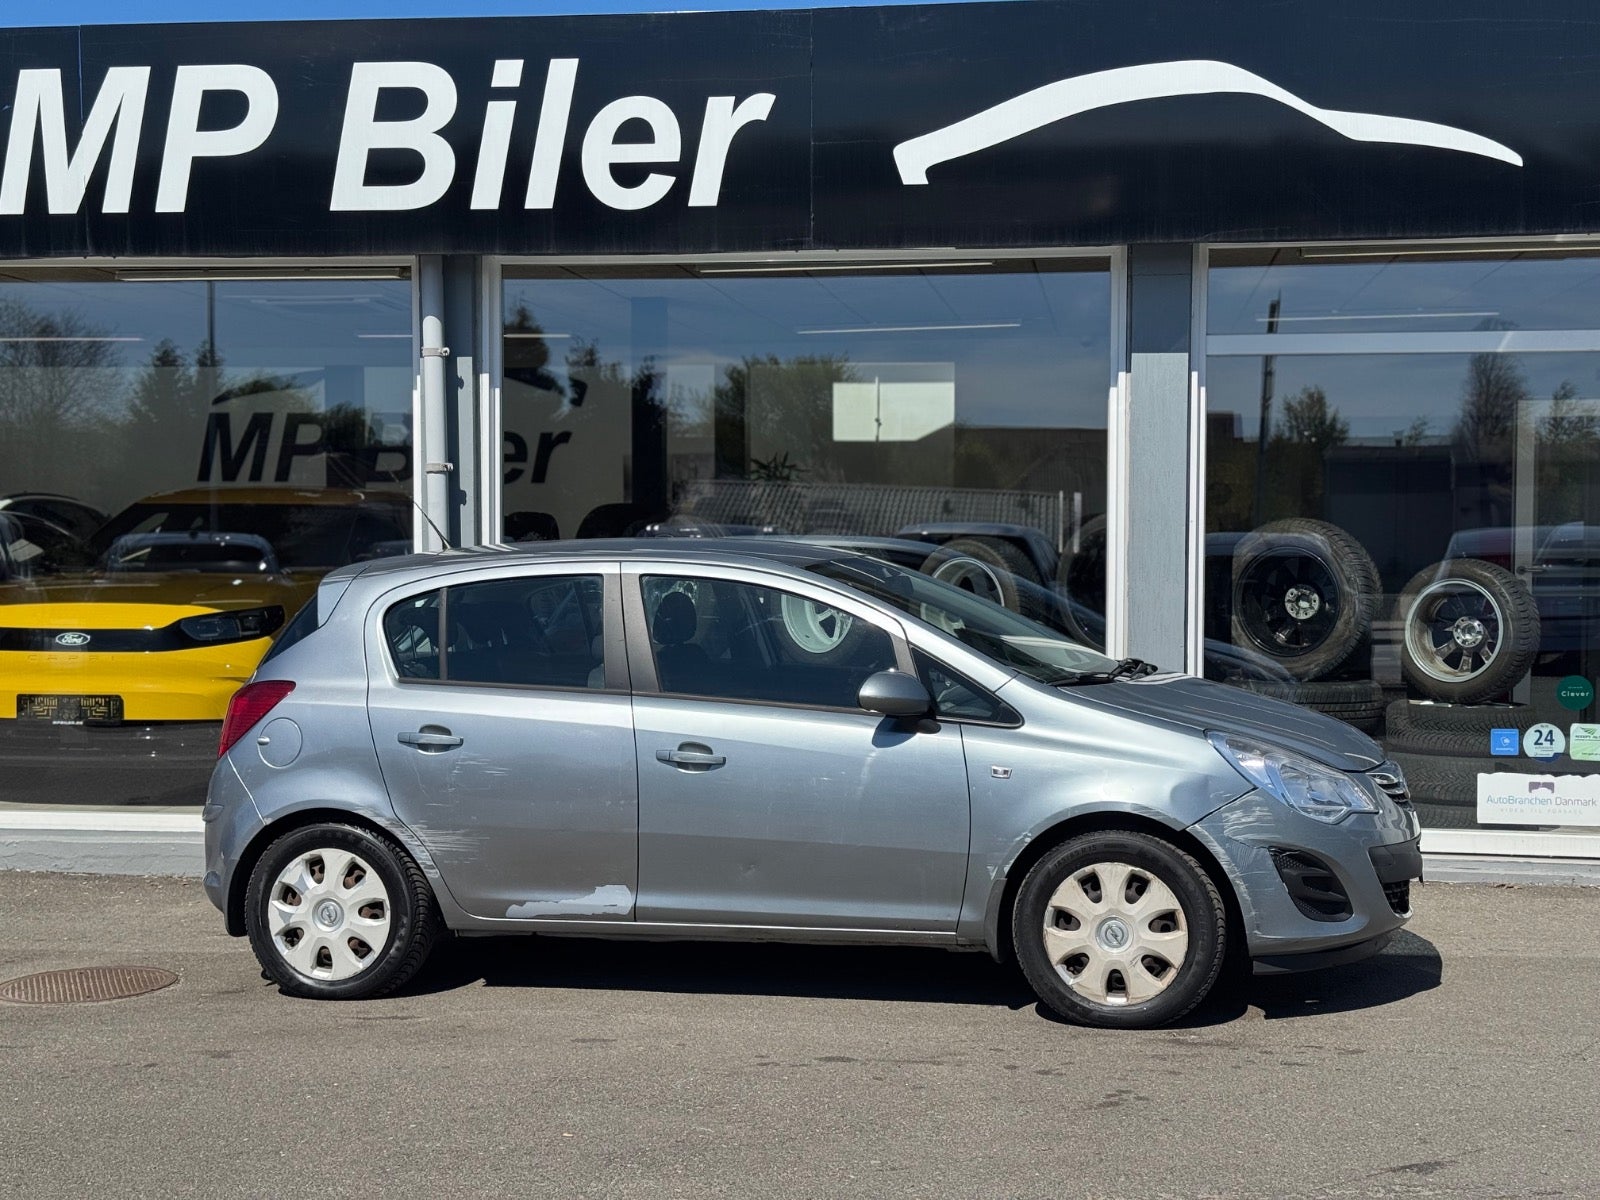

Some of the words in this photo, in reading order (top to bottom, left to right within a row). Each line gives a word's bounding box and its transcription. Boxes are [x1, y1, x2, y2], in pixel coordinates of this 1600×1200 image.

[0, 64, 279, 214] MP
[330, 59, 777, 212] Biler
[197, 412, 325, 482] MP
[61, 634, 84, 645] Ford
[1534, 729, 1555, 746] 24
[1487, 794, 1553, 806] AutoBranchen
[1554, 796, 1598, 807] Danmark
